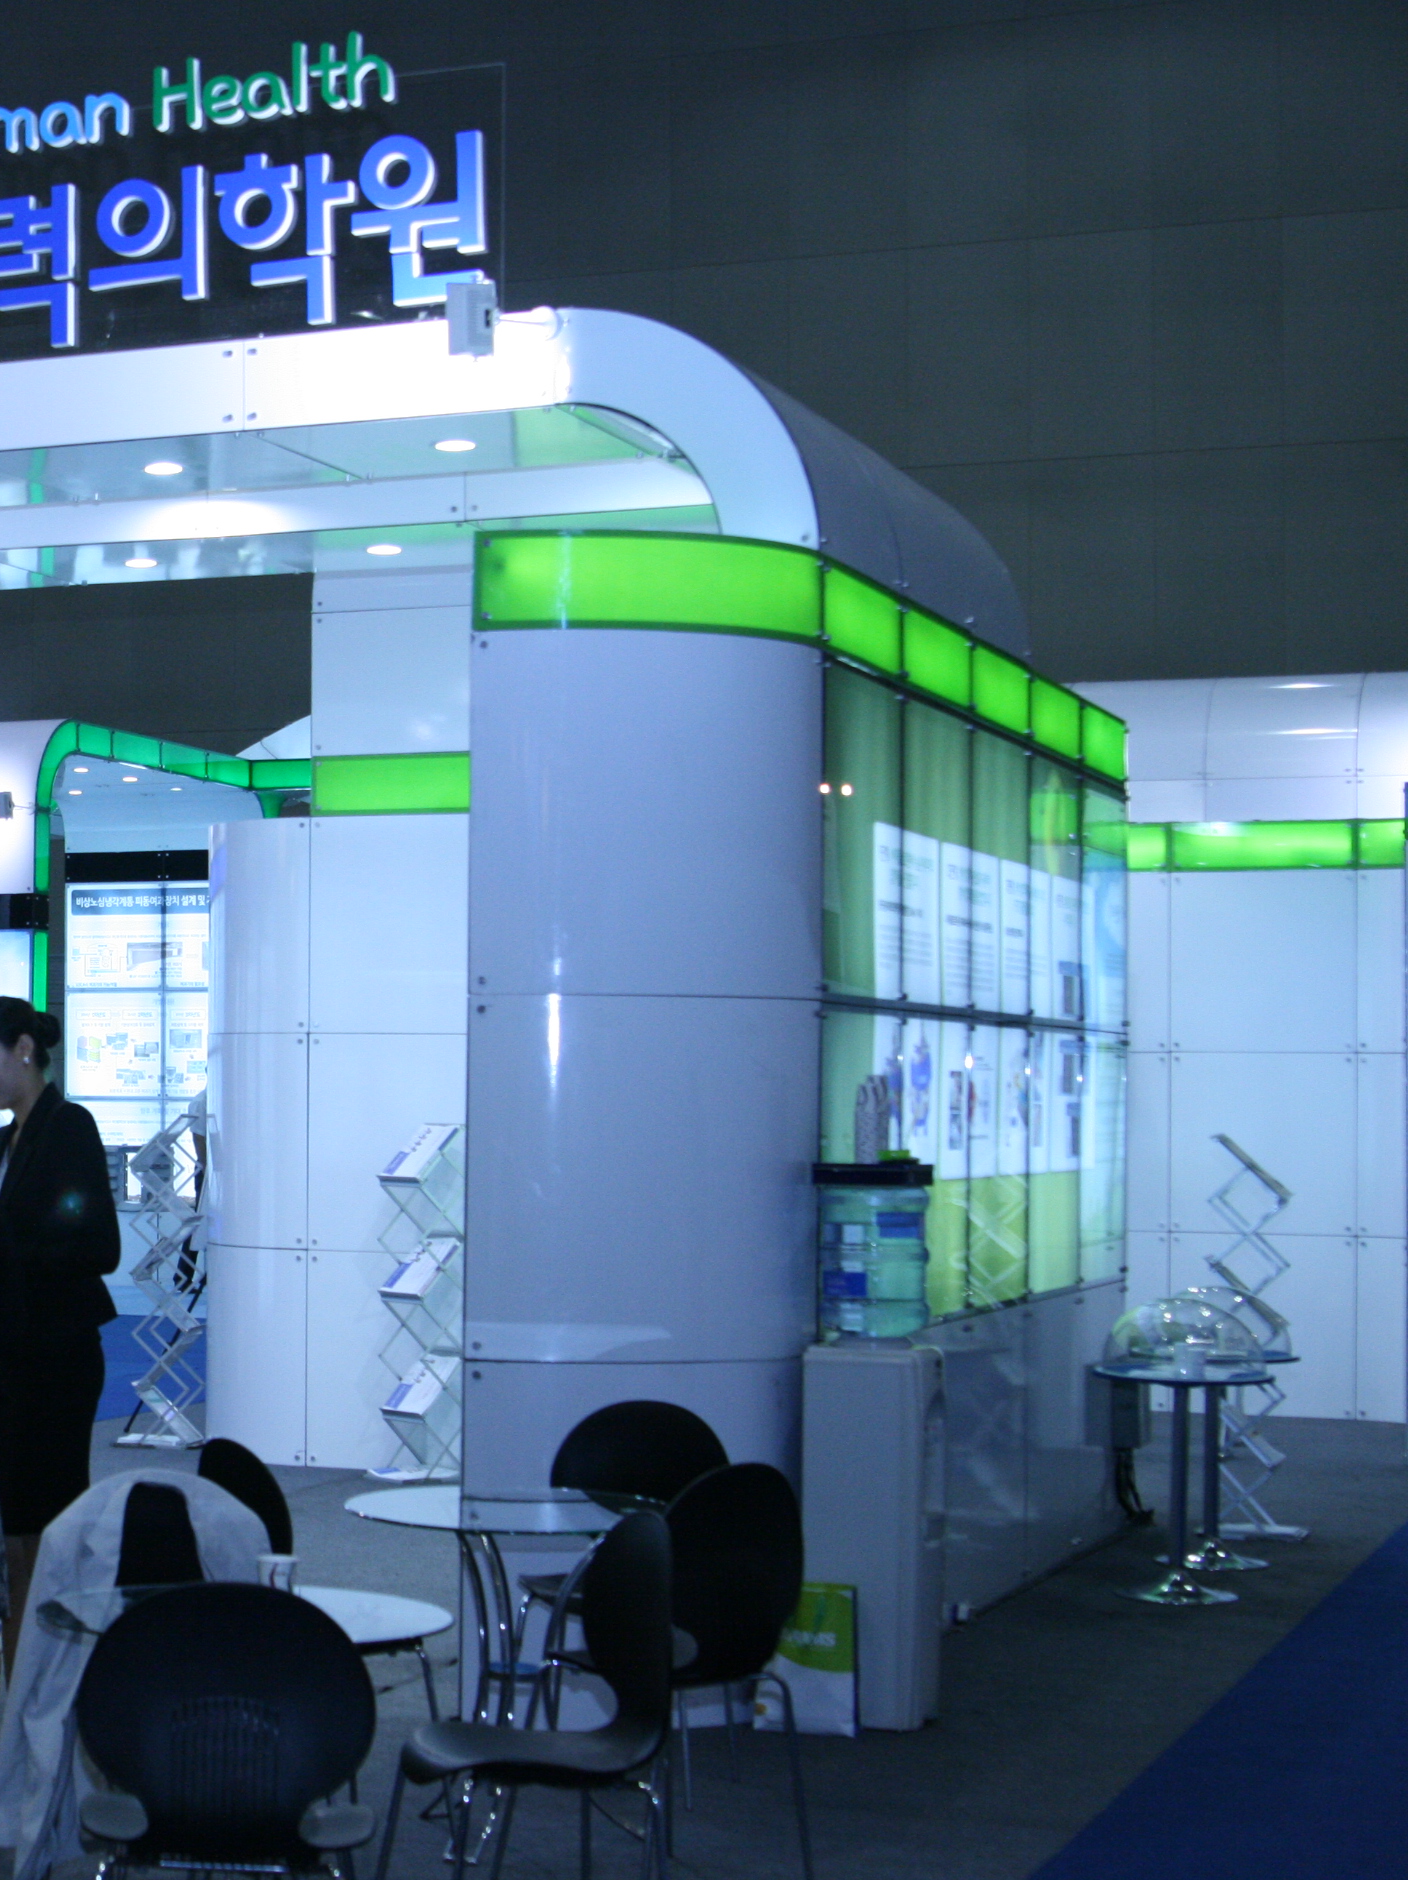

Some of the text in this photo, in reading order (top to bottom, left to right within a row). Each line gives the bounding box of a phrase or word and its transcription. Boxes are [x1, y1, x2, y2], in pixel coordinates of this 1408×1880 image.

[152, 32, 398, 132] Health
[182, 894, 197, 906] 설계
[198, 894, 206, 906] 및
